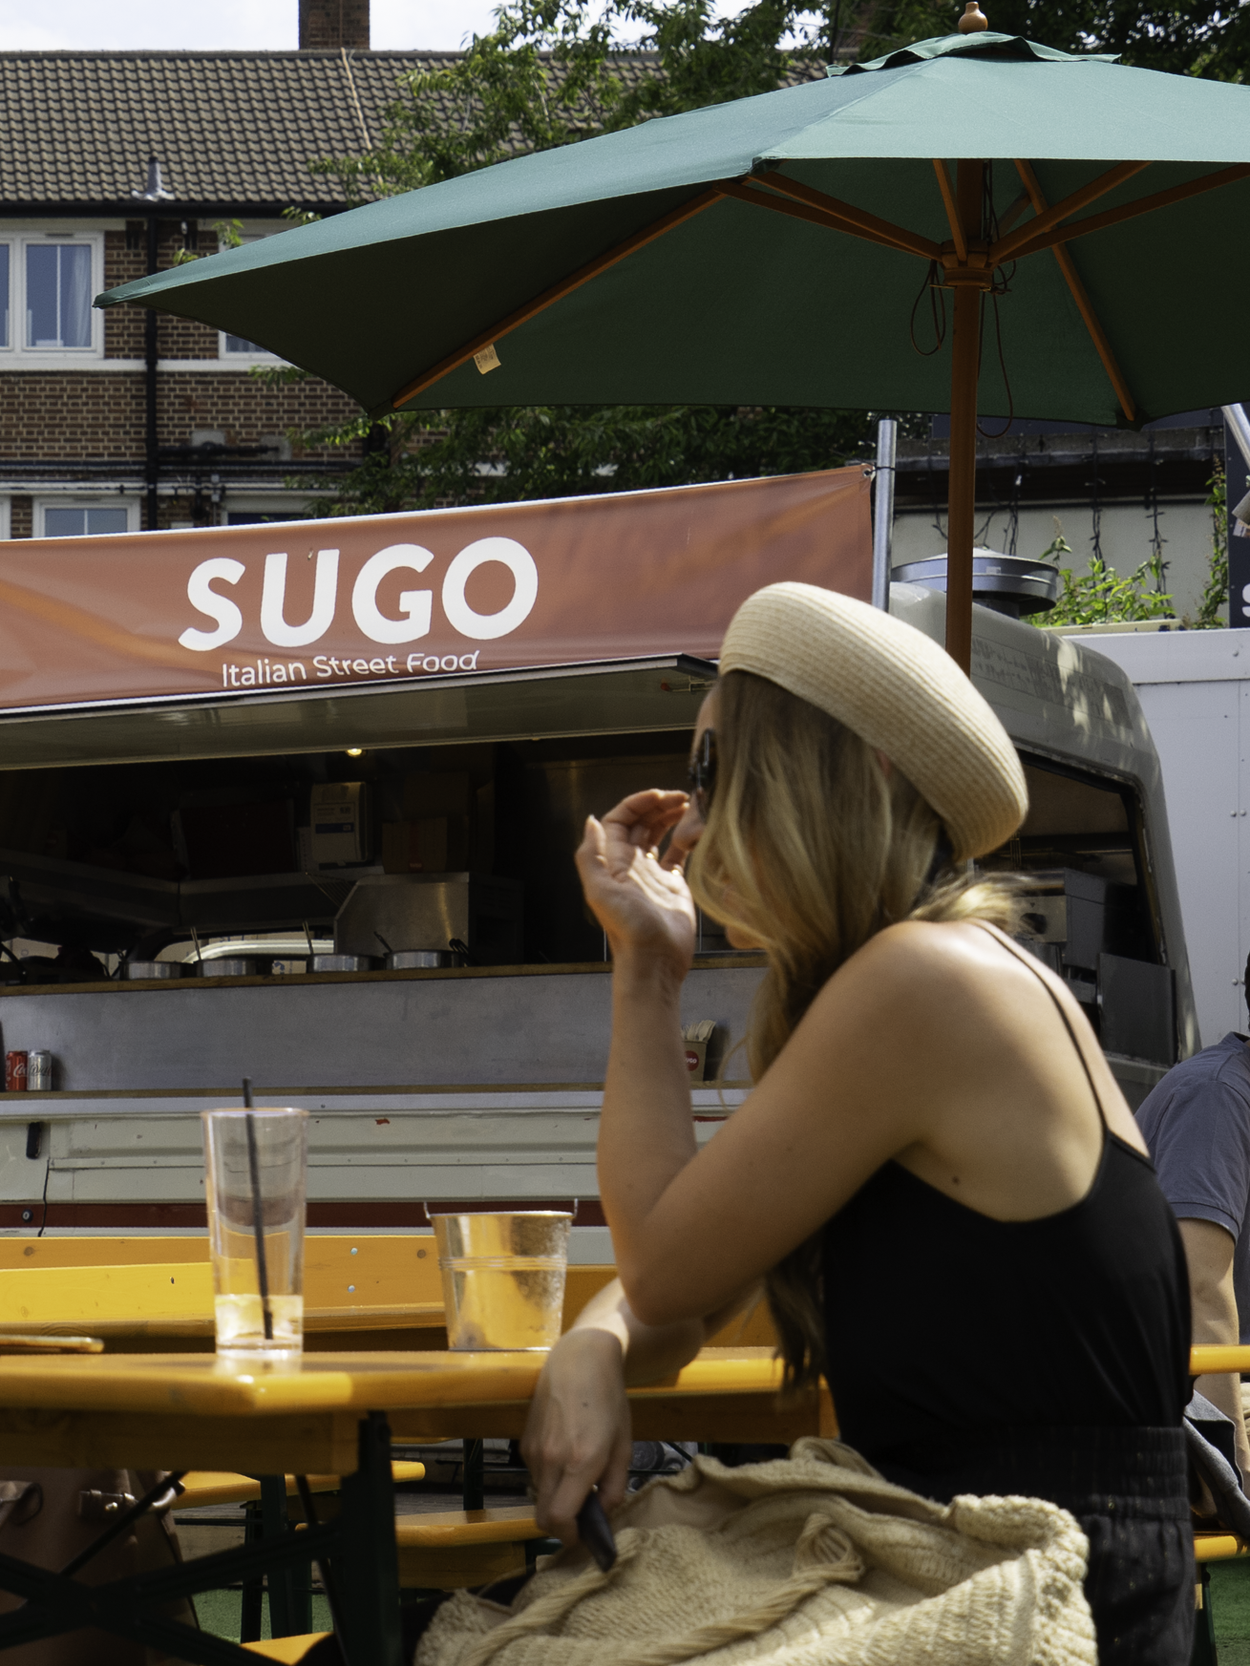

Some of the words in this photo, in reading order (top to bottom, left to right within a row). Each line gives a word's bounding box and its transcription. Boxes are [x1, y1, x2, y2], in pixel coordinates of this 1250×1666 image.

[178, 536, 538, 652] SUGO
[222, 658, 307, 688] Italian
[313, 654, 399, 678] Street
[406, 650, 480, 672] Food
